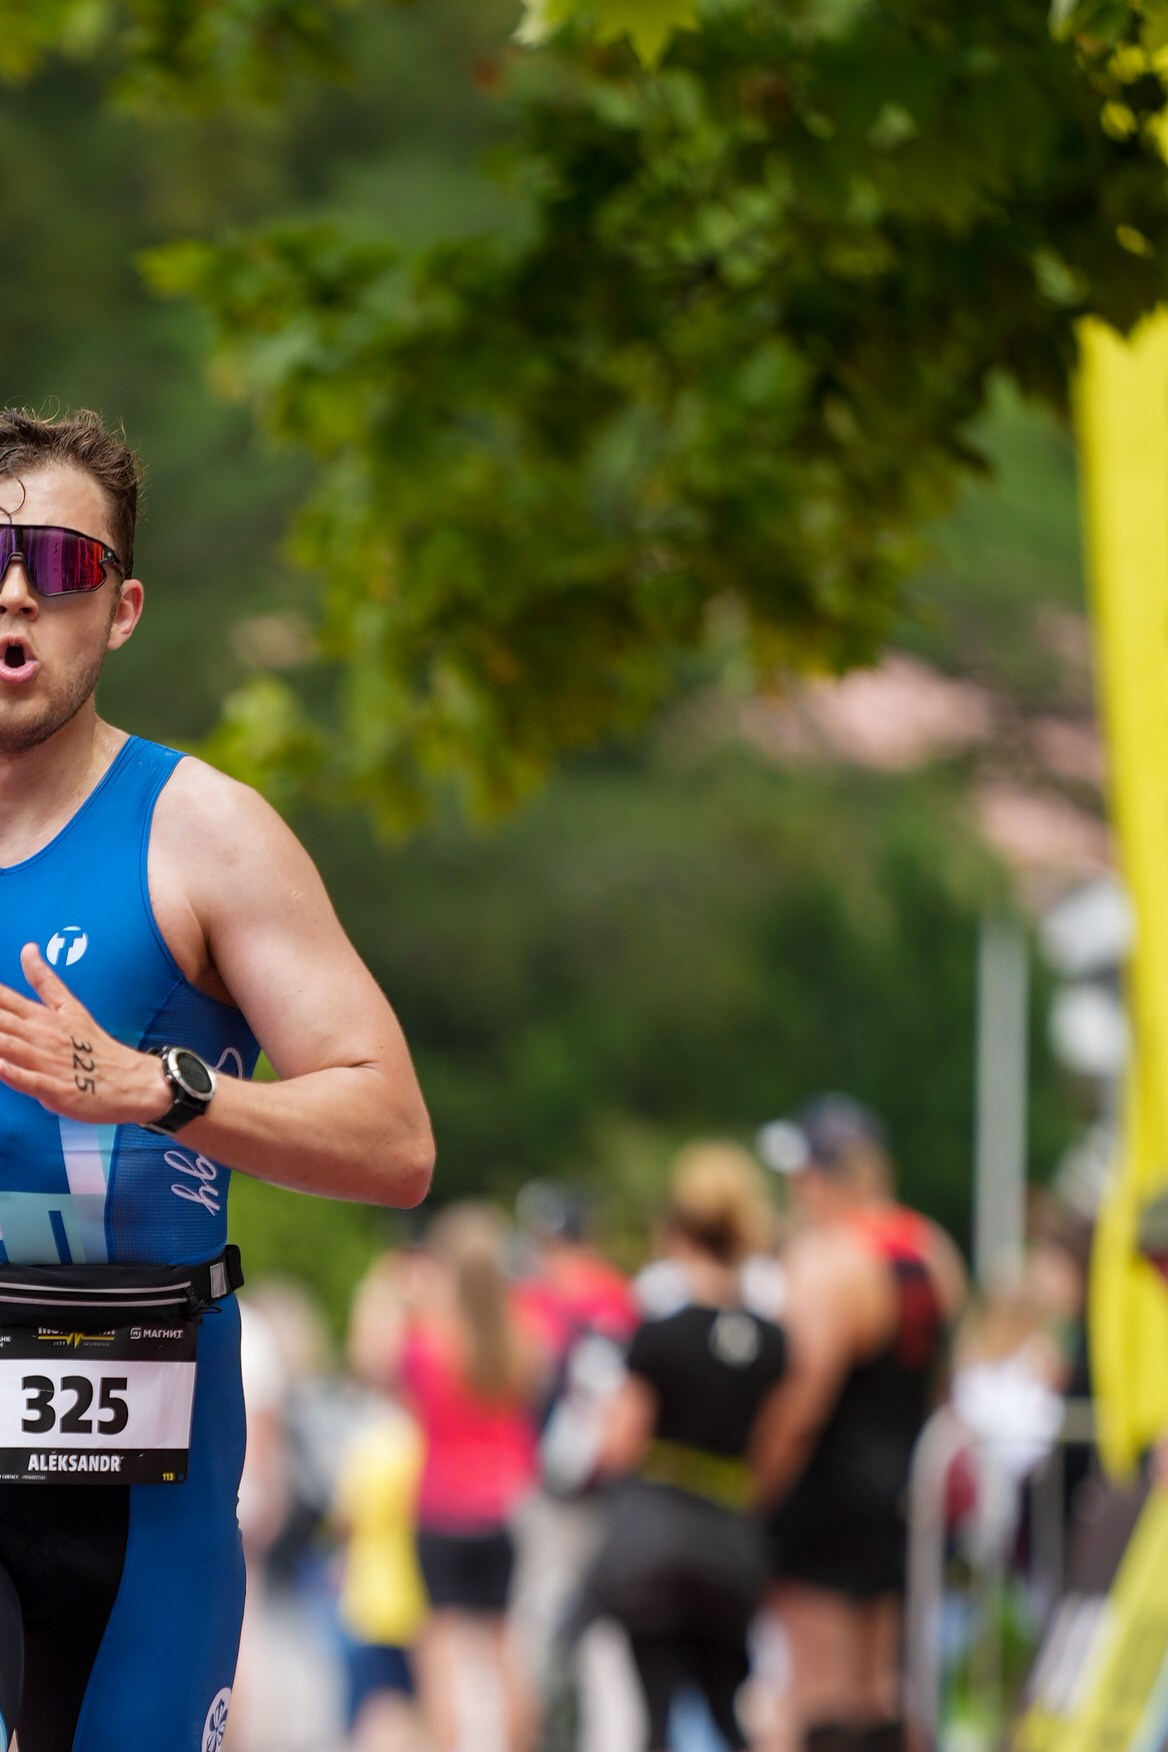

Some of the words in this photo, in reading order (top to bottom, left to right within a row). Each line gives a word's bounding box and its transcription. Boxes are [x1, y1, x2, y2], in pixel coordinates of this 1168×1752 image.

[70, 1035, 95, 1095] 325
[143, 1329, 183, 1338] МАГНИТ
[21, 1375, 129, 1435] 325
